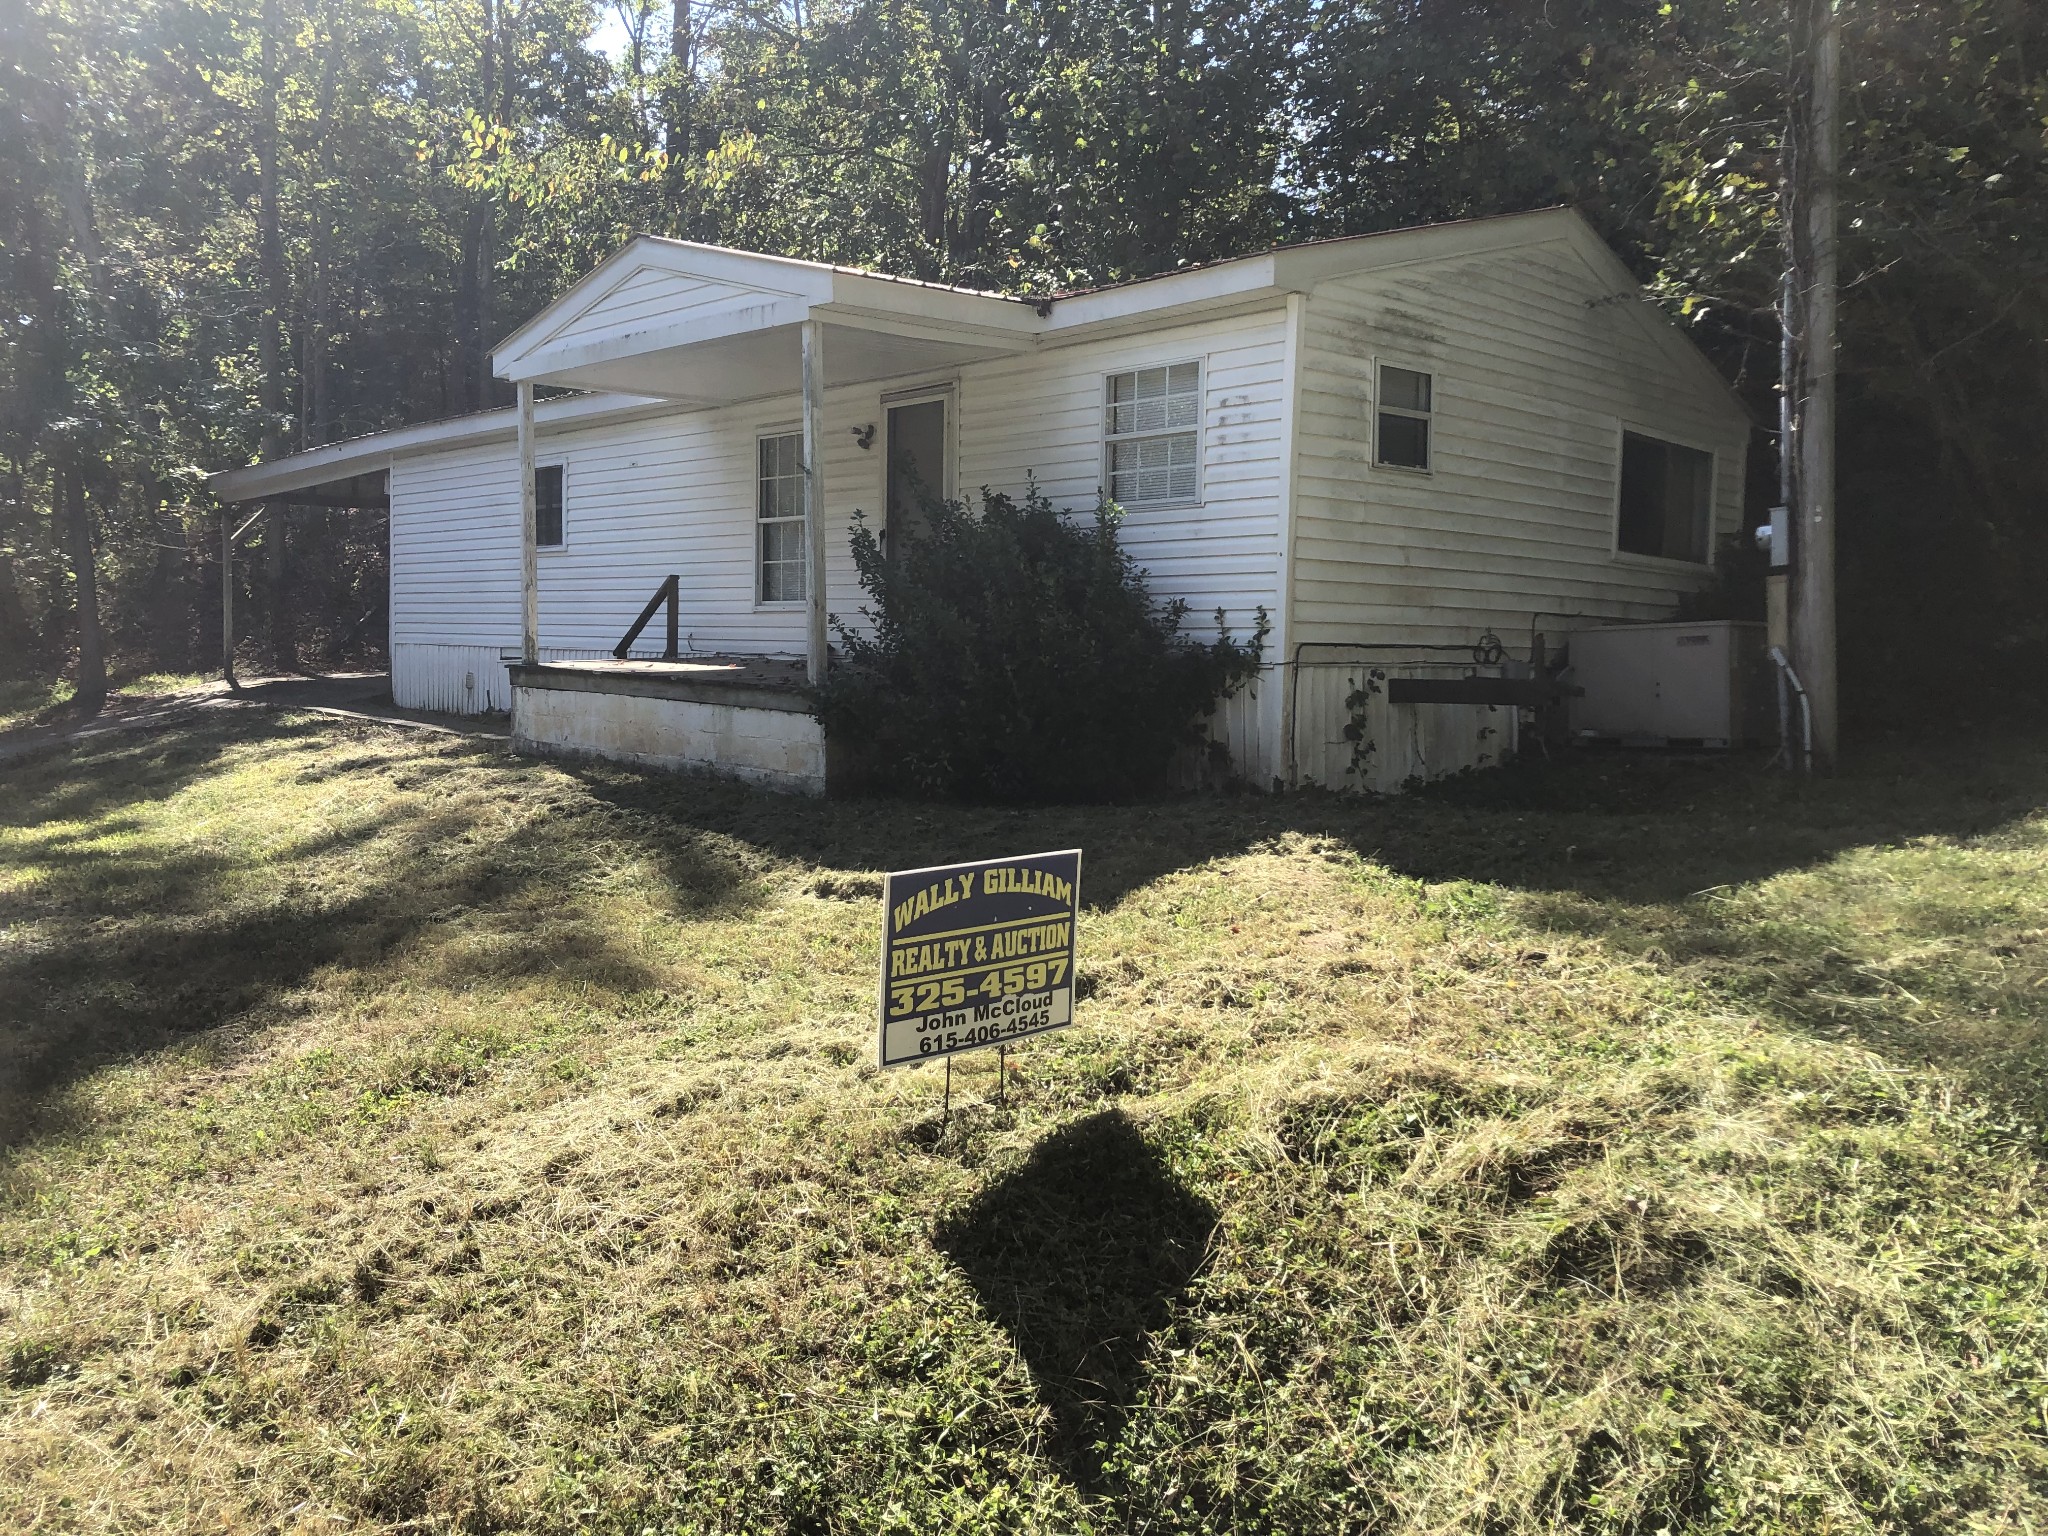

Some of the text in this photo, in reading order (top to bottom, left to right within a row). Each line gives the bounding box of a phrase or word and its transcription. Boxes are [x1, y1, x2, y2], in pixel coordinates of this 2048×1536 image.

[894, 868, 1072, 933] WALLY GILLIAM
[891, 922, 1070, 977] REALTY & AUCTION
[890, 958, 1068, 1016] 325-4597
[916, 991, 1052, 1032] John McCloud
[920, 1010, 1049, 1053] 615-406-4545
